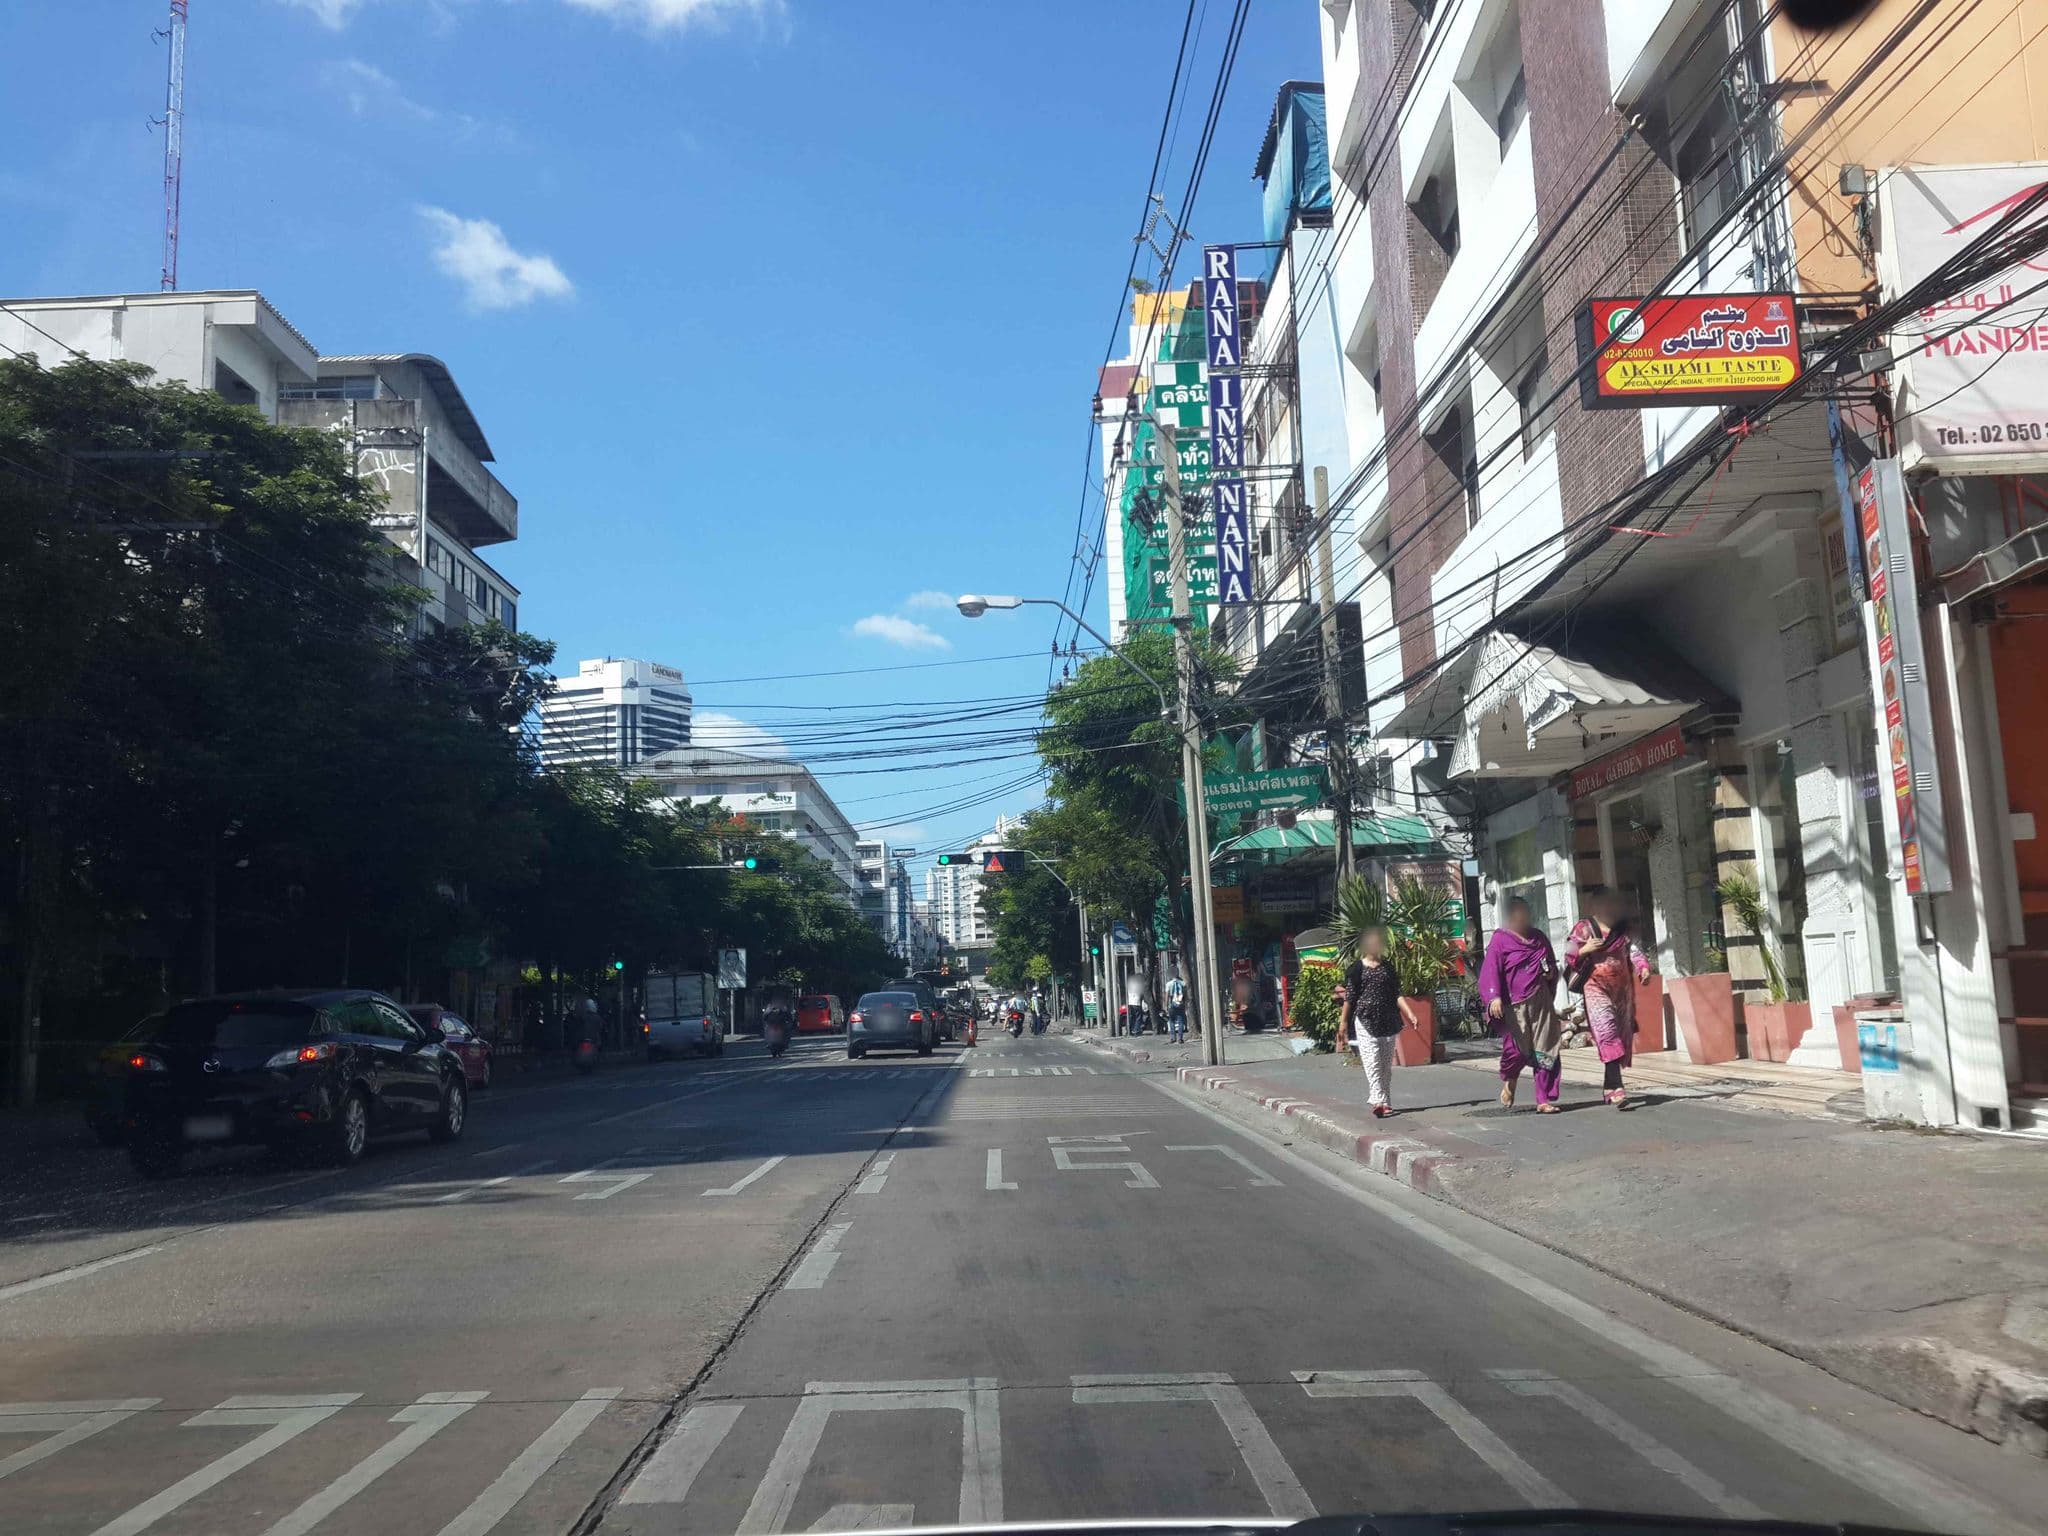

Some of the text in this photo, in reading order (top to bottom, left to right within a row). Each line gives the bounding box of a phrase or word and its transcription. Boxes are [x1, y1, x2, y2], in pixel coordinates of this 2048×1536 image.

[1722, 359, 1782, 373] TASTE
[1161, 384, 1209, 403] คลินิ
[1207, 250, 1247, 603] RANA INN NANA
[1937, 427, 1969, 446] Tel.
[1980, 425, 2003, 443] 02
[2006, 423, 2042, 441] 650
[1575, 739, 1678, 796] ROYAL GARDEN HOME
